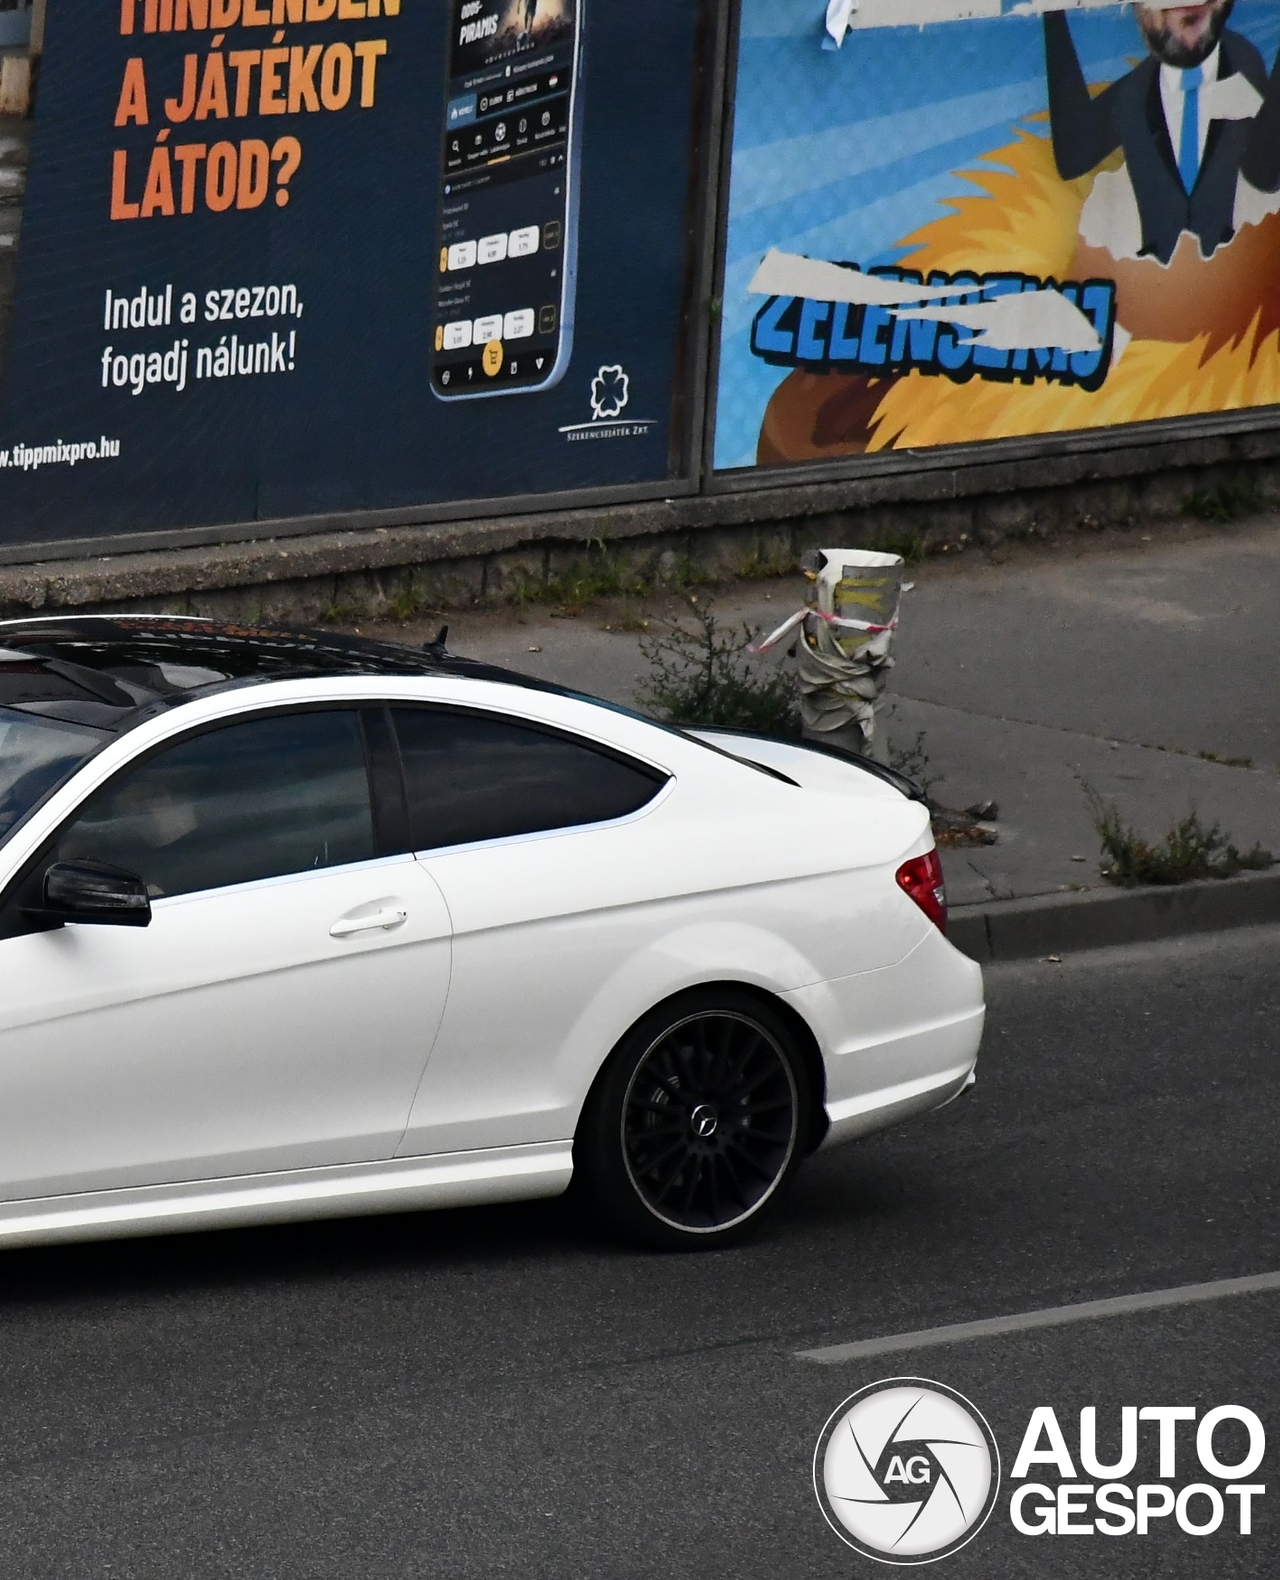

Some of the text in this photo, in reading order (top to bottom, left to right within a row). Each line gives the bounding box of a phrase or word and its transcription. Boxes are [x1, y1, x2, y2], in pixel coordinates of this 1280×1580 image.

[459, 13, 499, 46] PIRAMIS
[114, 30, 387, 127] A JÁTÉKOT
[110, 128, 302, 220] LÁTOD?
[103, 283, 304, 330] Indul a szezon,
[101, 330, 297, 396] fogadj nálunk!
